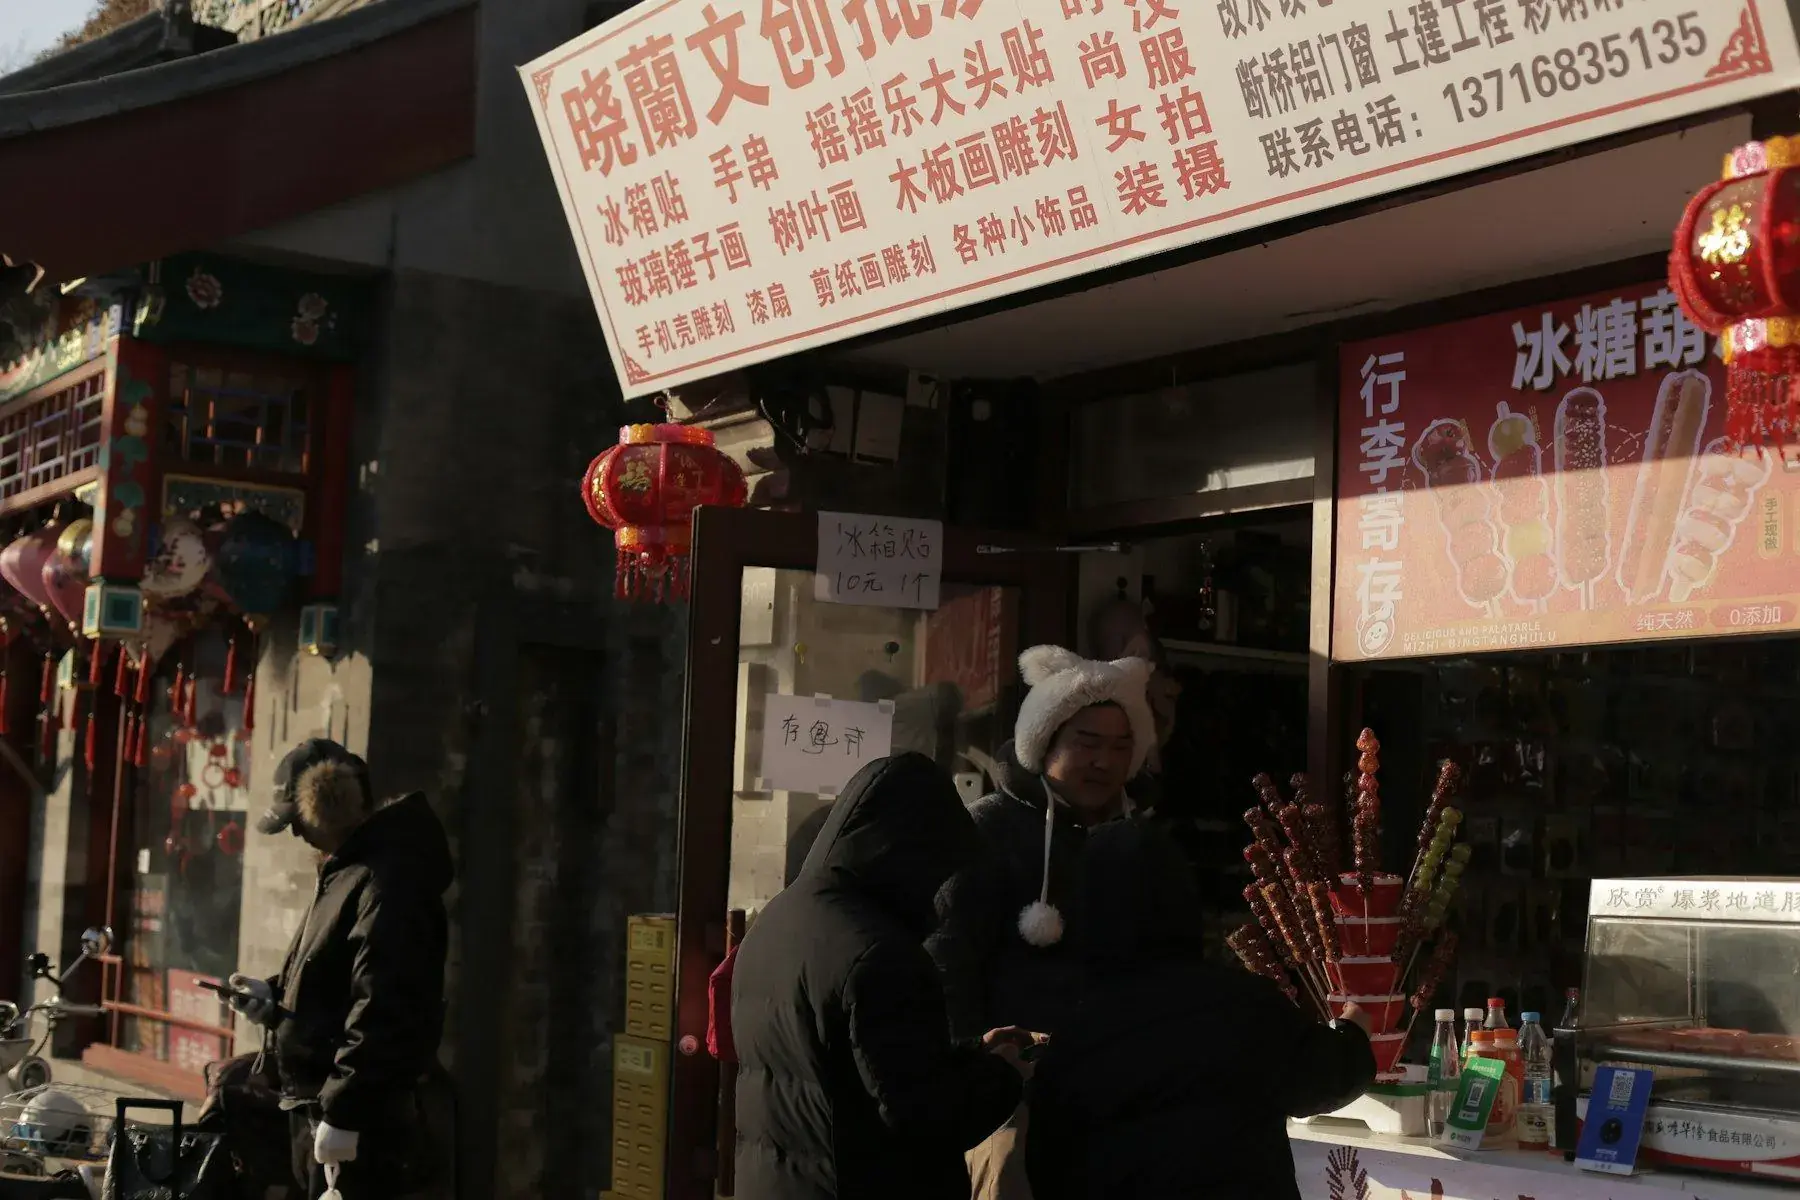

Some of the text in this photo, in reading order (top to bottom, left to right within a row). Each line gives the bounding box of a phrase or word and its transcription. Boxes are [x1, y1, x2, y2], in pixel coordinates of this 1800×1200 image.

[562, 0, 984, 178] 晓蘭文创批
[1235, 0, 1514, 121] 断桥铝门窗 土建工程
[1441, 12, 1708, 124] 13716835135
[596, 18, 1055, 247] 冰箱贴 手串 摇摇乐大头贴
[616, 100, 1079, 307] 玻璃锤子画 树叶画 木板画雕刻
[635, 185, 1099, 359] 手机壳雕刻 漆扇 剪纸画雕刻 各种小饰品
[1511, 289, 1725, 389] 冰糖葫
[837, 522, 933, 560] 冰箱贴
[837, 571, 883, 594] 10元
[1635, 605, 1781, 631] 纯天然 0添加
